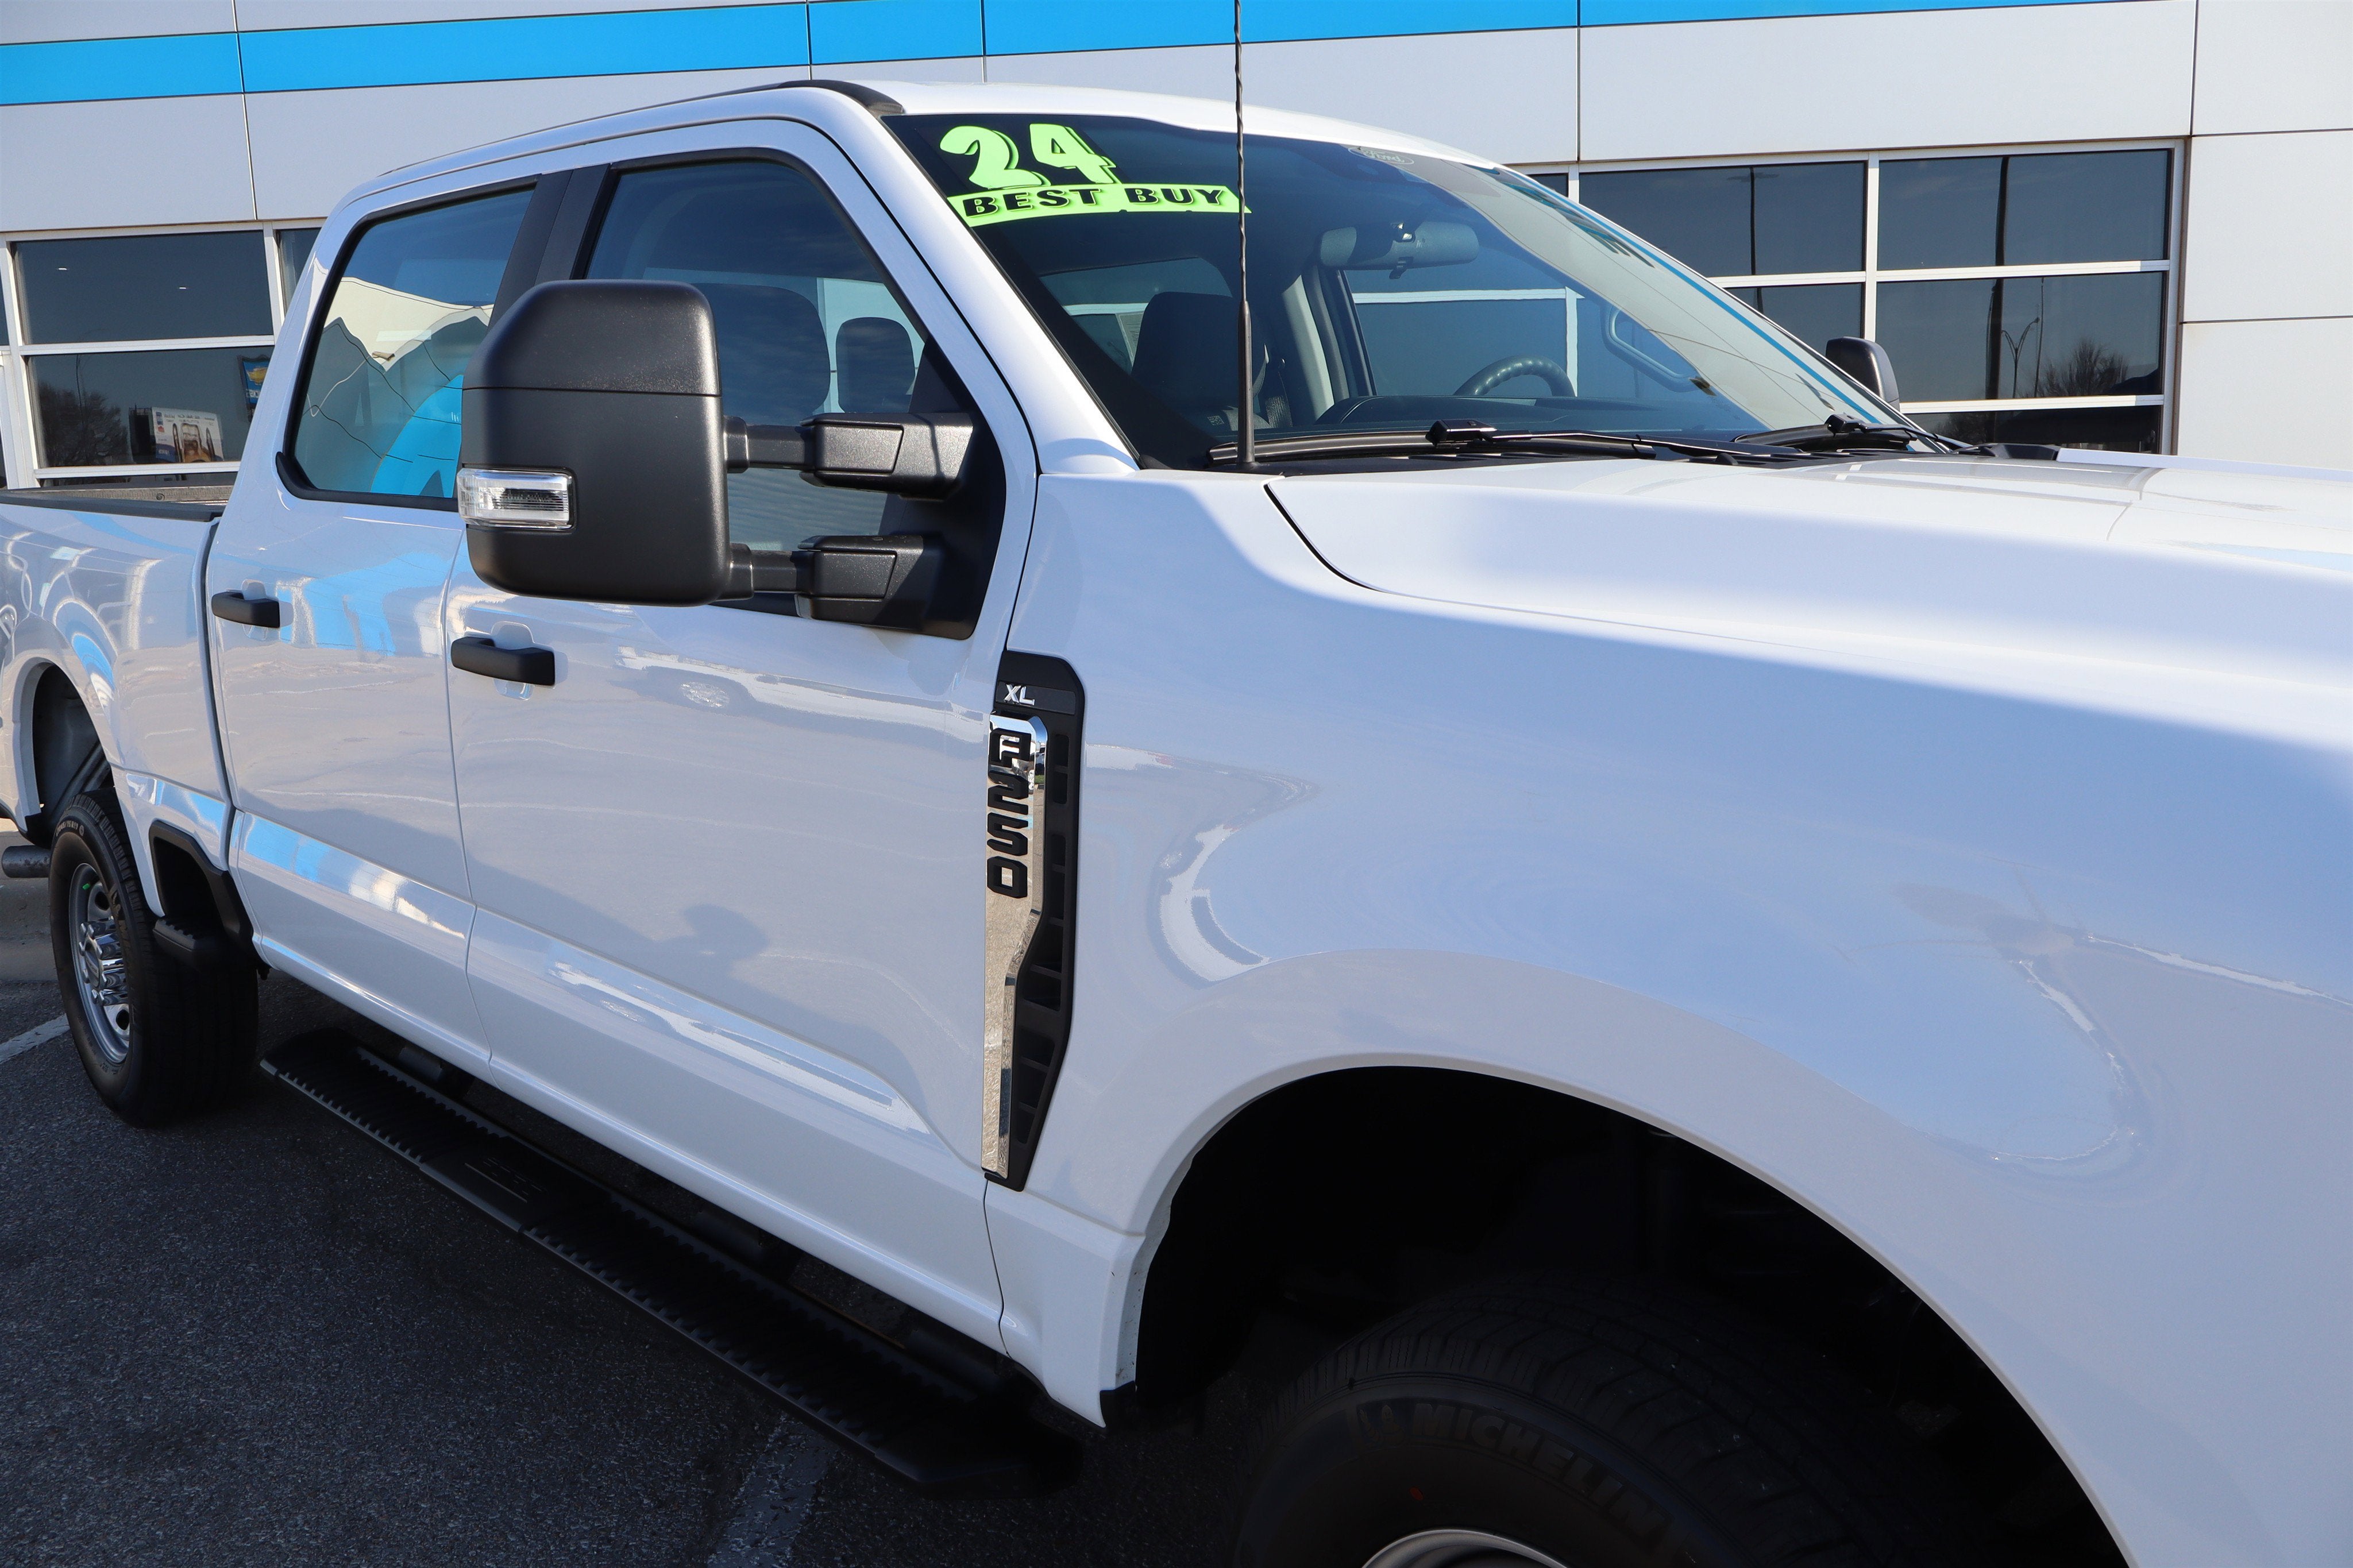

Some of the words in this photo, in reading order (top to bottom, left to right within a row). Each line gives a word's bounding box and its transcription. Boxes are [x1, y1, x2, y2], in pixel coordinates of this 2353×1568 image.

[939, 123, 1117, 189] 24
[963, 188, 1101, 217] BEST
[1127, 188, 1224, 205] BUY
[1004, 683, 1035, 706] XL
[987, 728, 1032, 898] F250
[1414, 1403, 1673, 1542] MICHELIN
